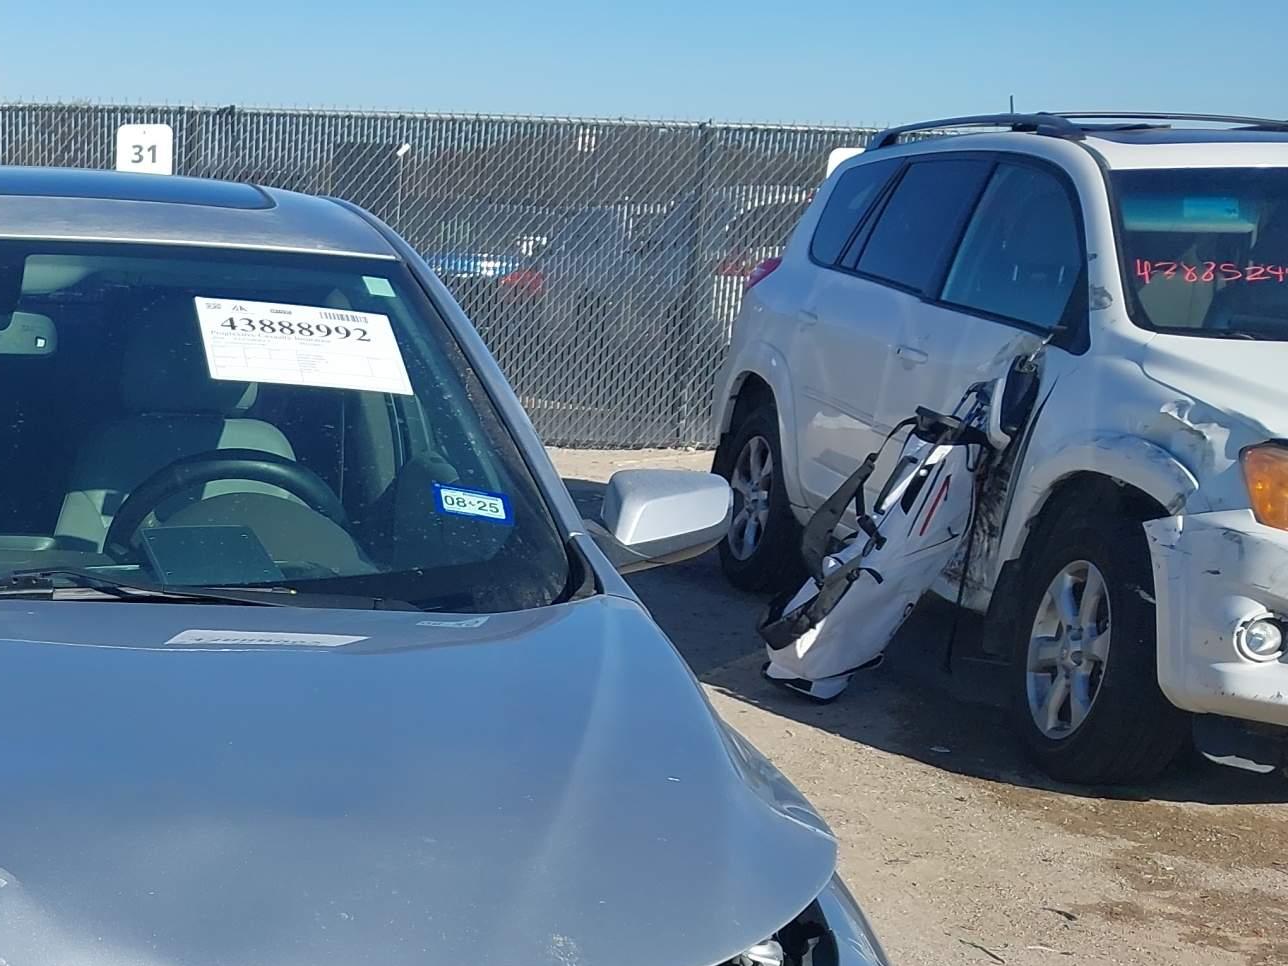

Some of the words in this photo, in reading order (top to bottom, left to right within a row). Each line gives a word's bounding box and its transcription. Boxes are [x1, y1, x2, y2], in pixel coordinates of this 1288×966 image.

[131, 144, 157, 163] 31
[1136, 258, 1288, 285] 4388524
[220, 316, 372, 343] 43888992
